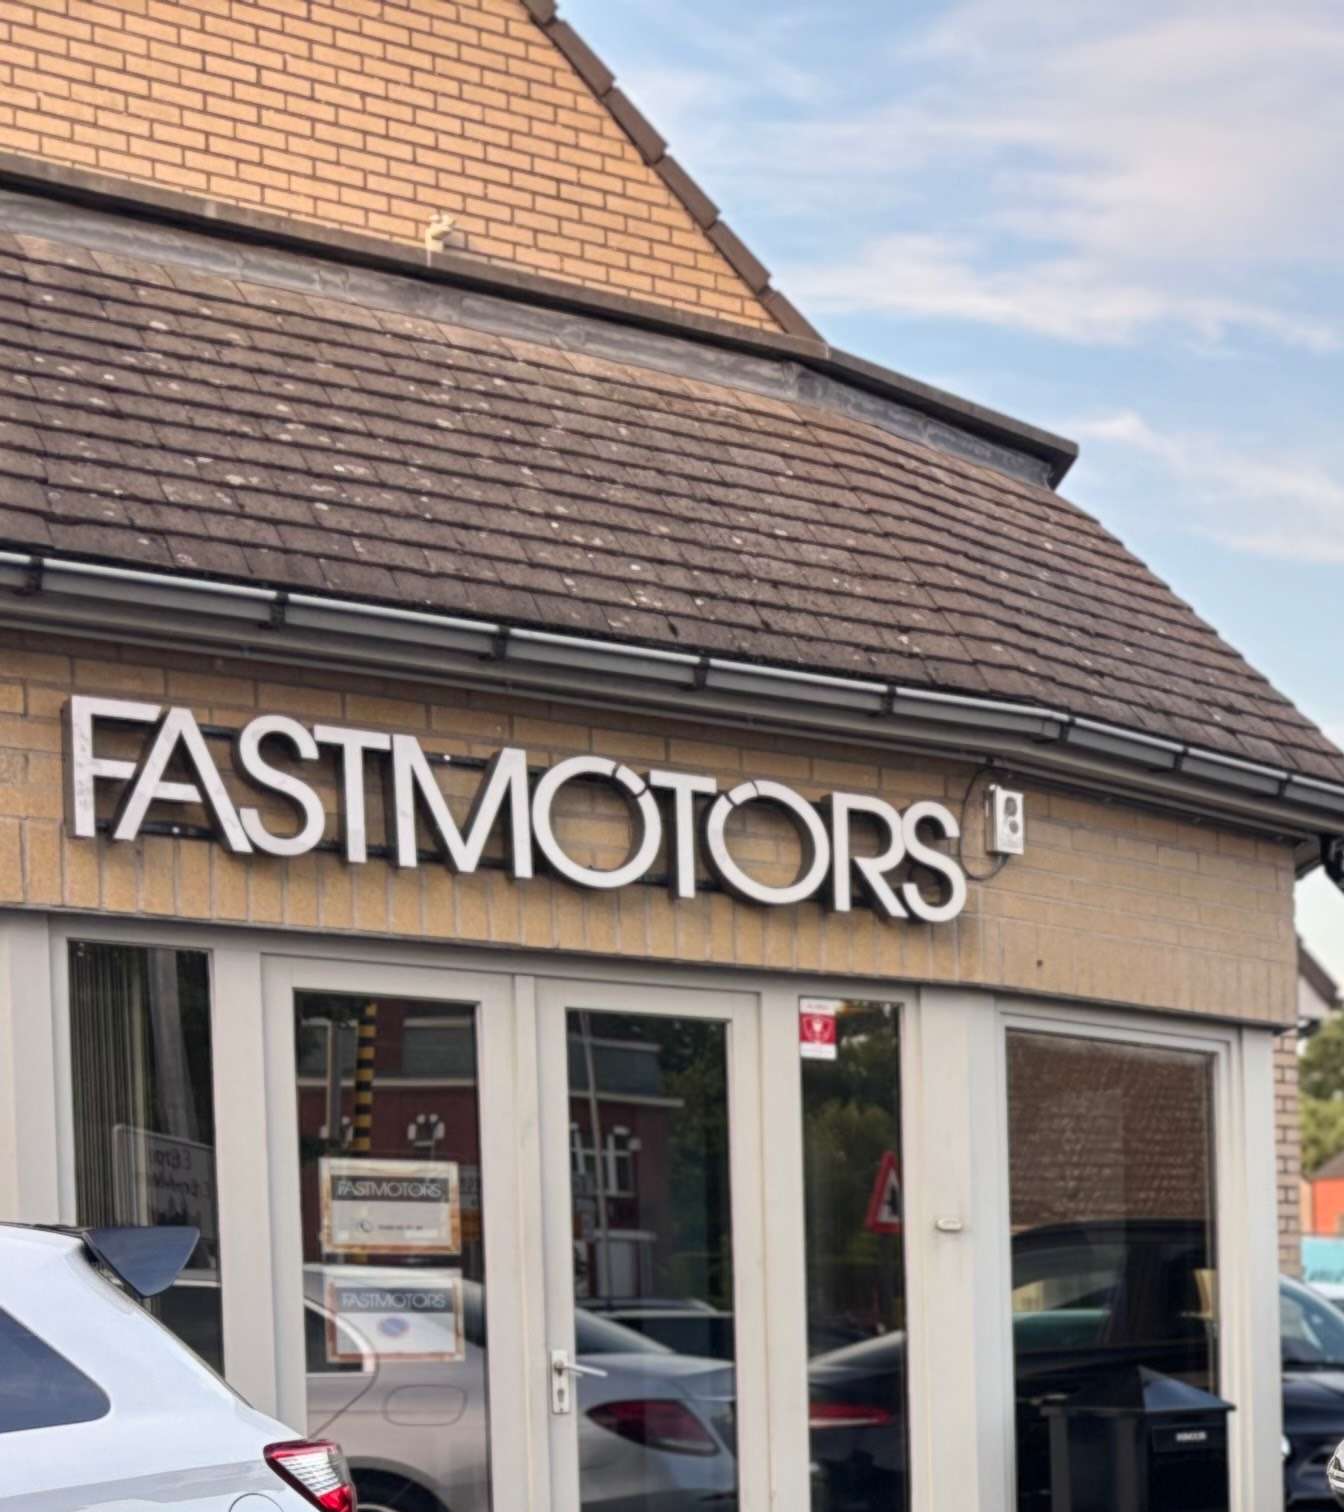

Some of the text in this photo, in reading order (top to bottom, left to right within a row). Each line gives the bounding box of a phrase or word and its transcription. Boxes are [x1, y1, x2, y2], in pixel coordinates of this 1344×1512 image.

[66, 695, 967, 923] FASTMOTORS
[337, 1180, 441, 1197] FASTMOTORS
[342, 1292, 446, 1309] FASTMOTORS
